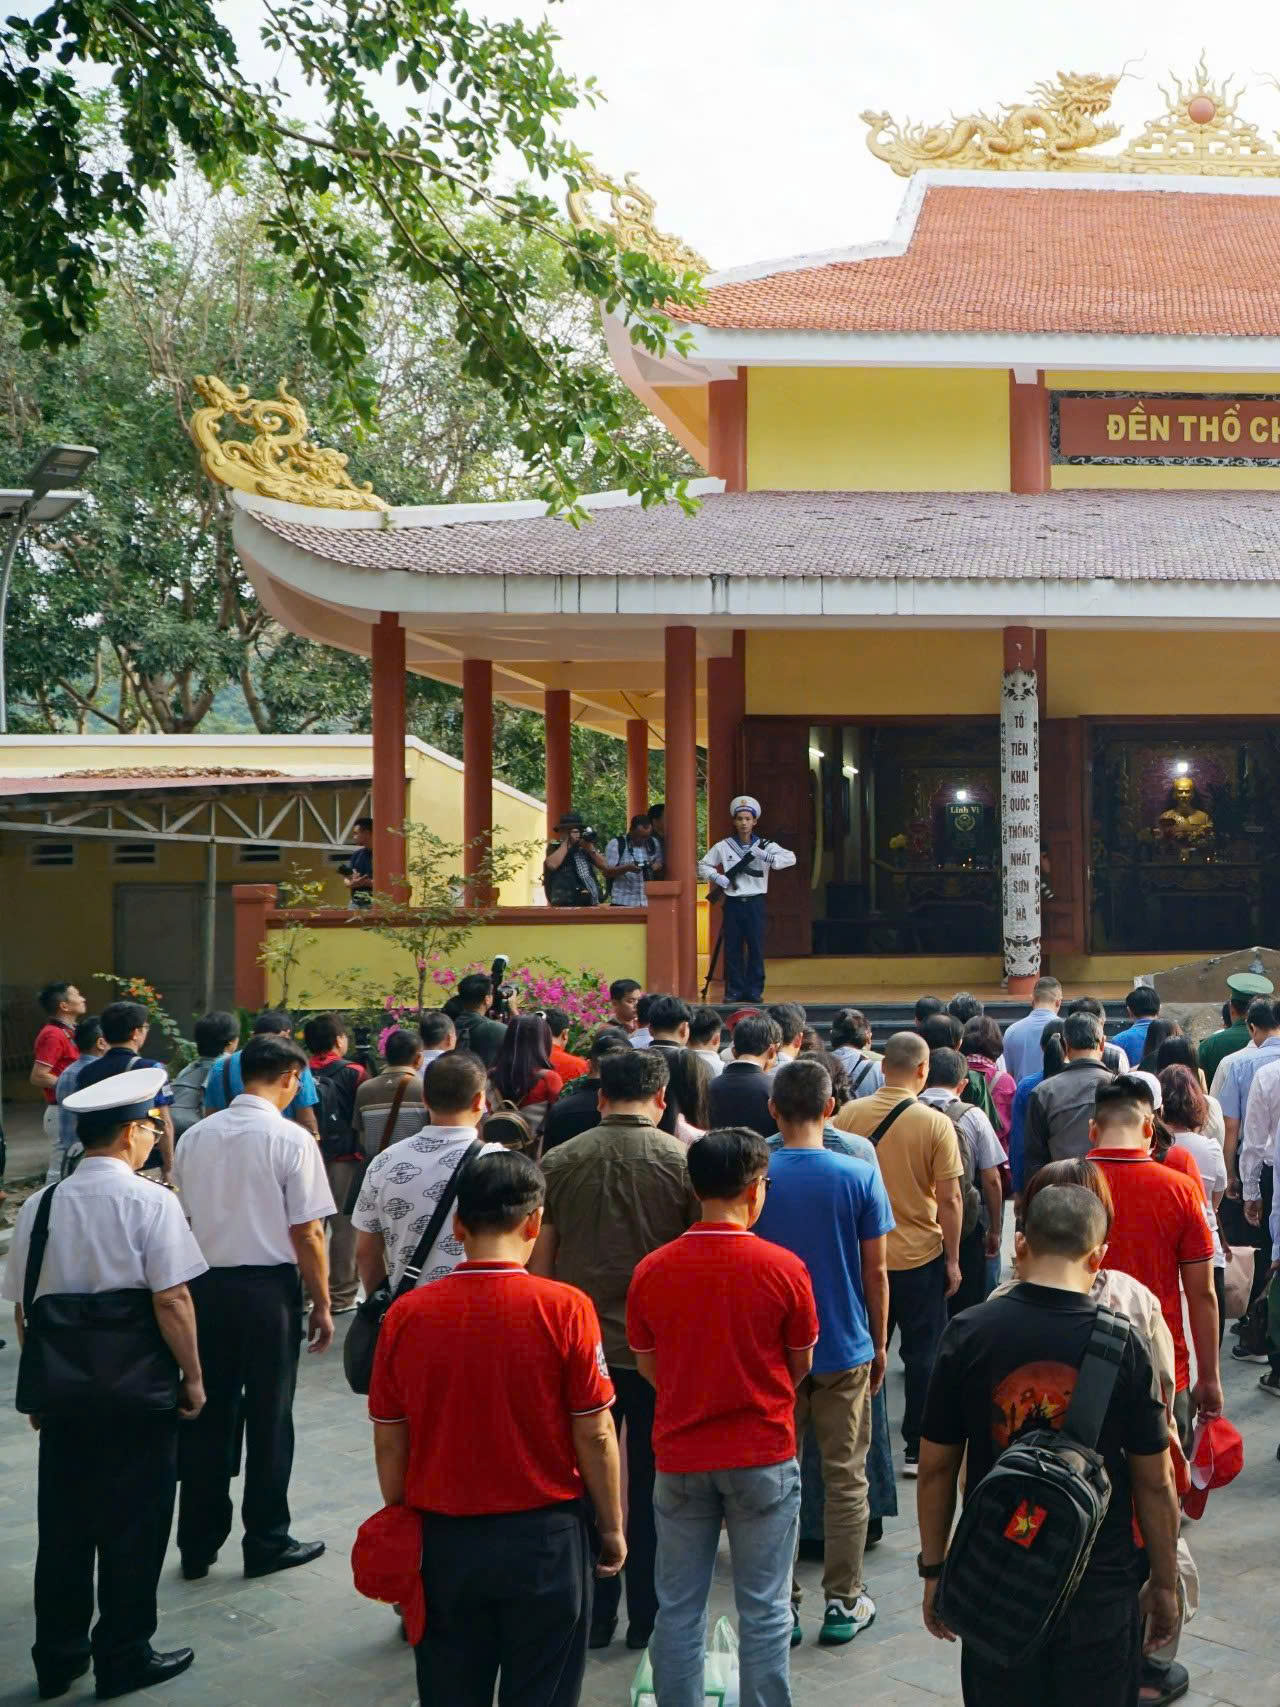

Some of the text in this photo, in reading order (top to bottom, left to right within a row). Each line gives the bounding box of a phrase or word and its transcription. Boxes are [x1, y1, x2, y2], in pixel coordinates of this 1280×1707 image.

[1106, 400, 1171, 442] ĐỀN
[1177, 403, 1241, 443] THỔ
[1010, 740, 1029, 756] TIÊN
[1010, 770, 1029, 784] KHAI
